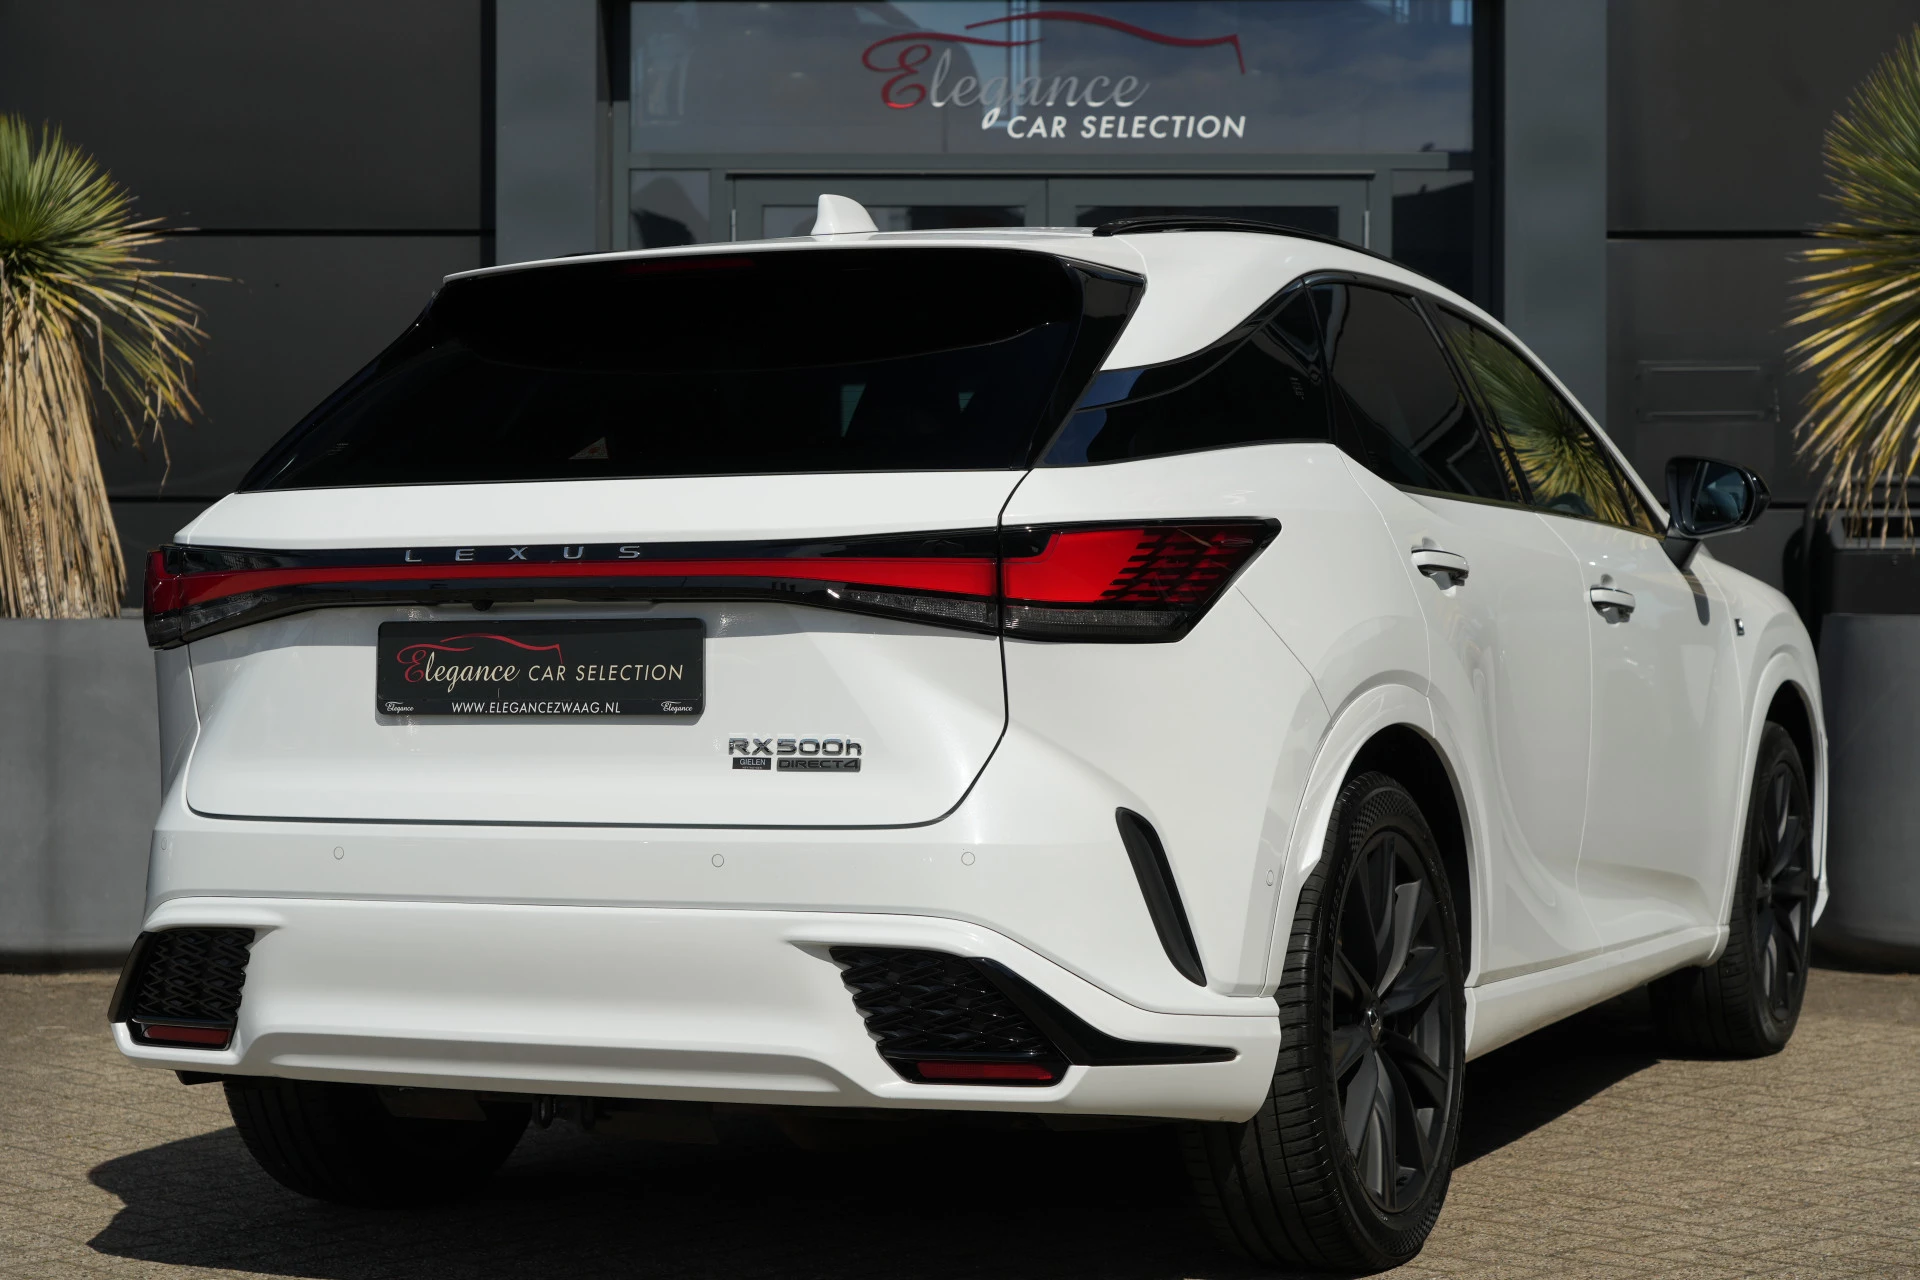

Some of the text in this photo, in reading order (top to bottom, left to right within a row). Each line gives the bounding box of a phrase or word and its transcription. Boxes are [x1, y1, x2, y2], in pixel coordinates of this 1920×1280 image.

[862, 33, 1150, 130] Elegance
[1006, 115, 1246, 138] CAR SELECTION
[404, 545, 641, 563] LEXUS
[397, 644, 684, 693] Elegance CAR SELECTION
[385, 701, 414, 713] Elegance
[451, 701, 621, 714] WWW.ELEGANCEZWAAG.NL
[661, 700, 693, 713] Elegance
[739, 758, 766, 766] GIELEN
[778, 759, 859, 769] DIRECT4
